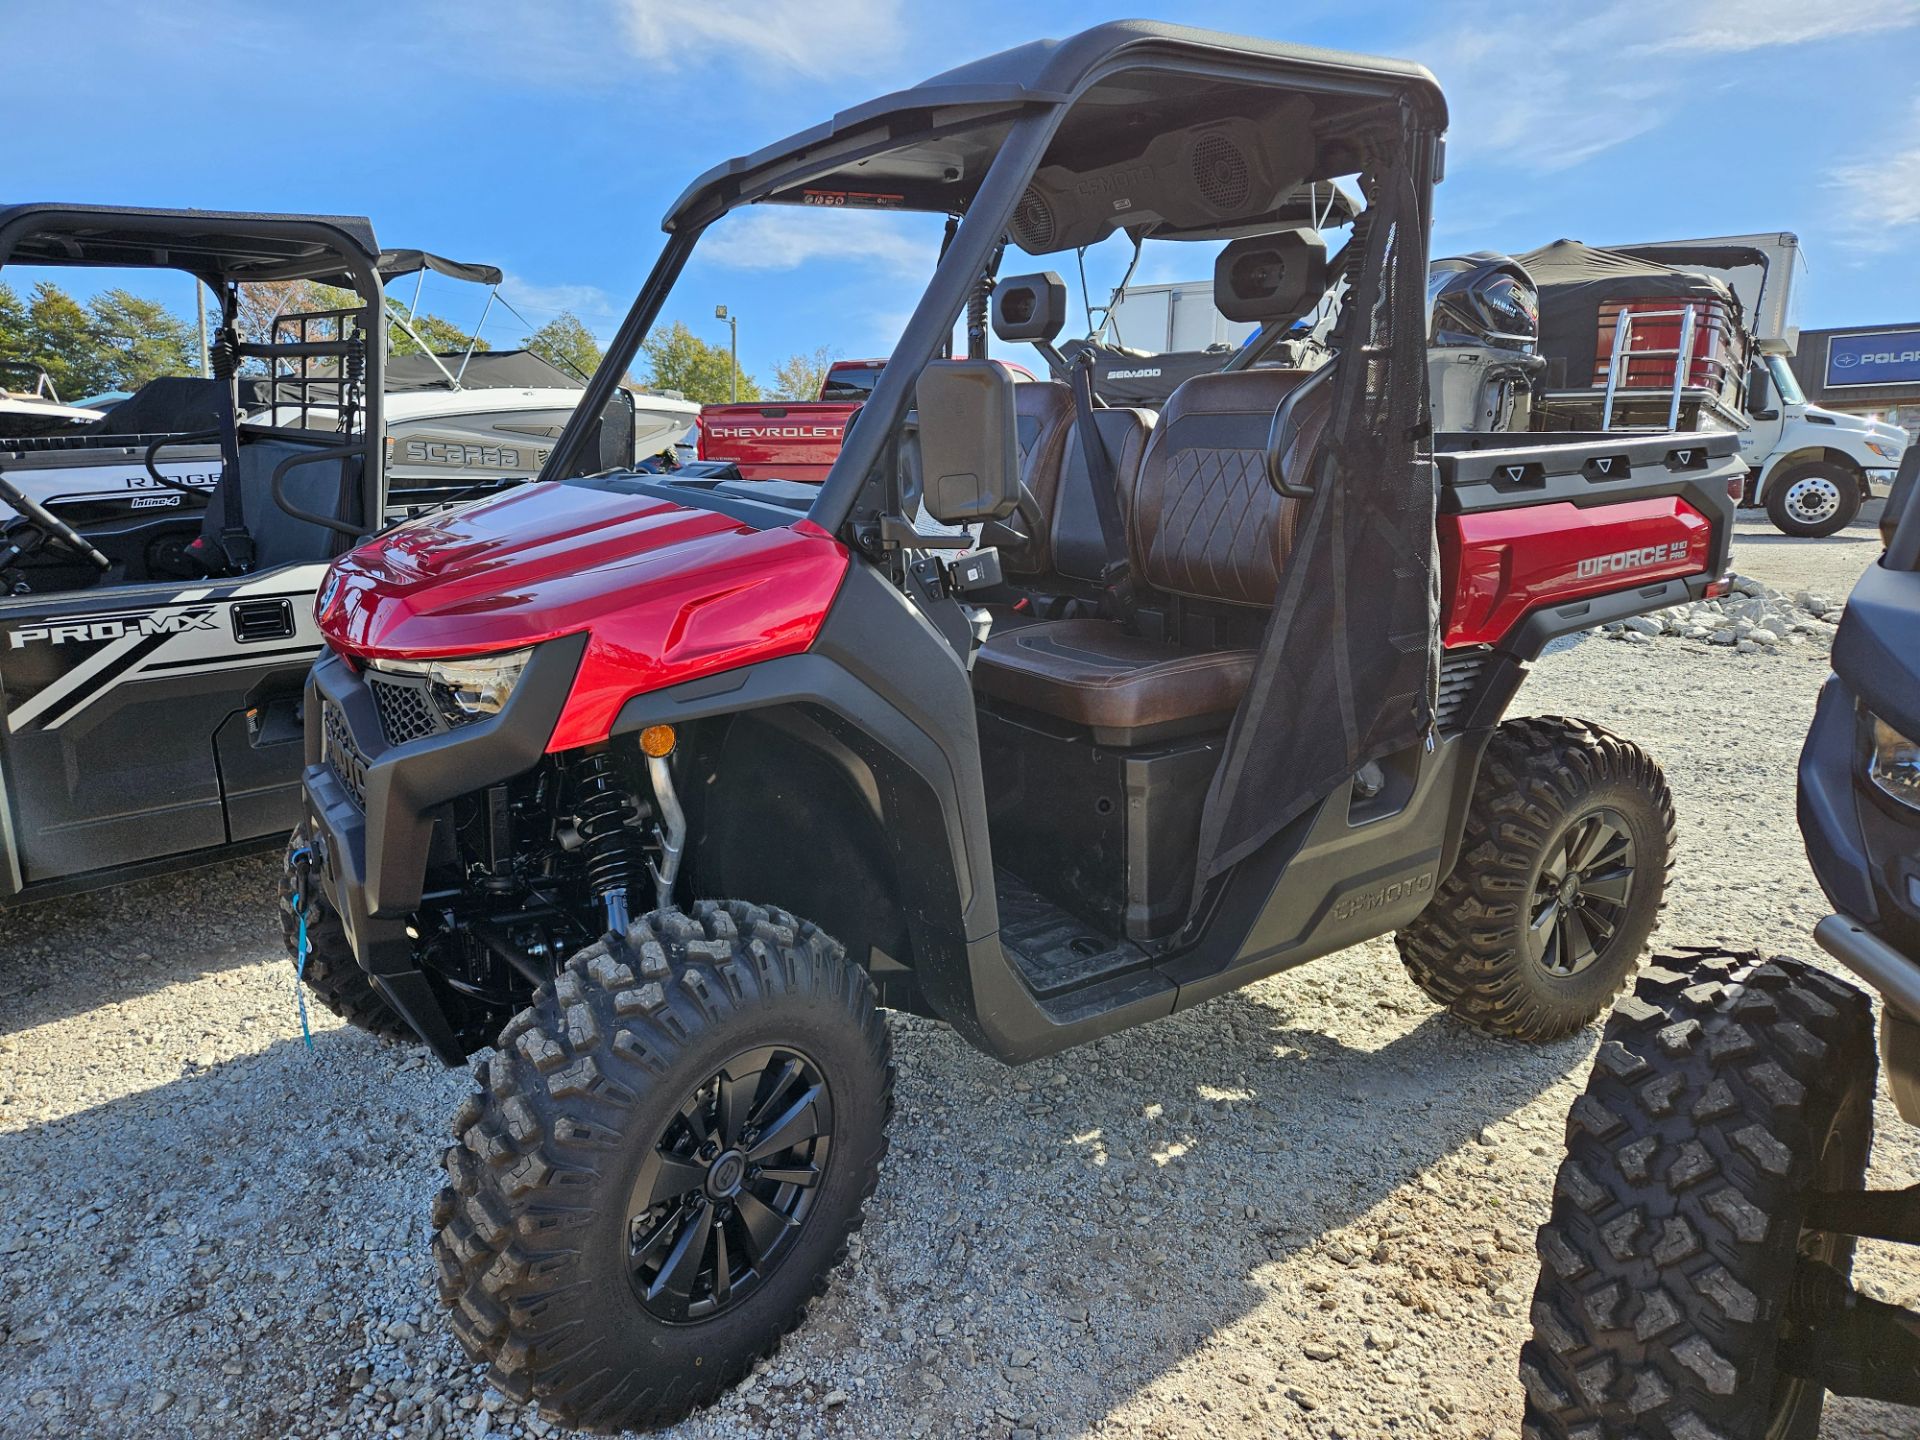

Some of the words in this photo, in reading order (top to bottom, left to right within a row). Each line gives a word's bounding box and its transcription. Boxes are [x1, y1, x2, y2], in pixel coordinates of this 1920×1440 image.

[711, 427, 843, 438] CHEVROLET
[1670, 550, 1686, 561] PRO
[8, 611, 220, 650] PRO-MX
